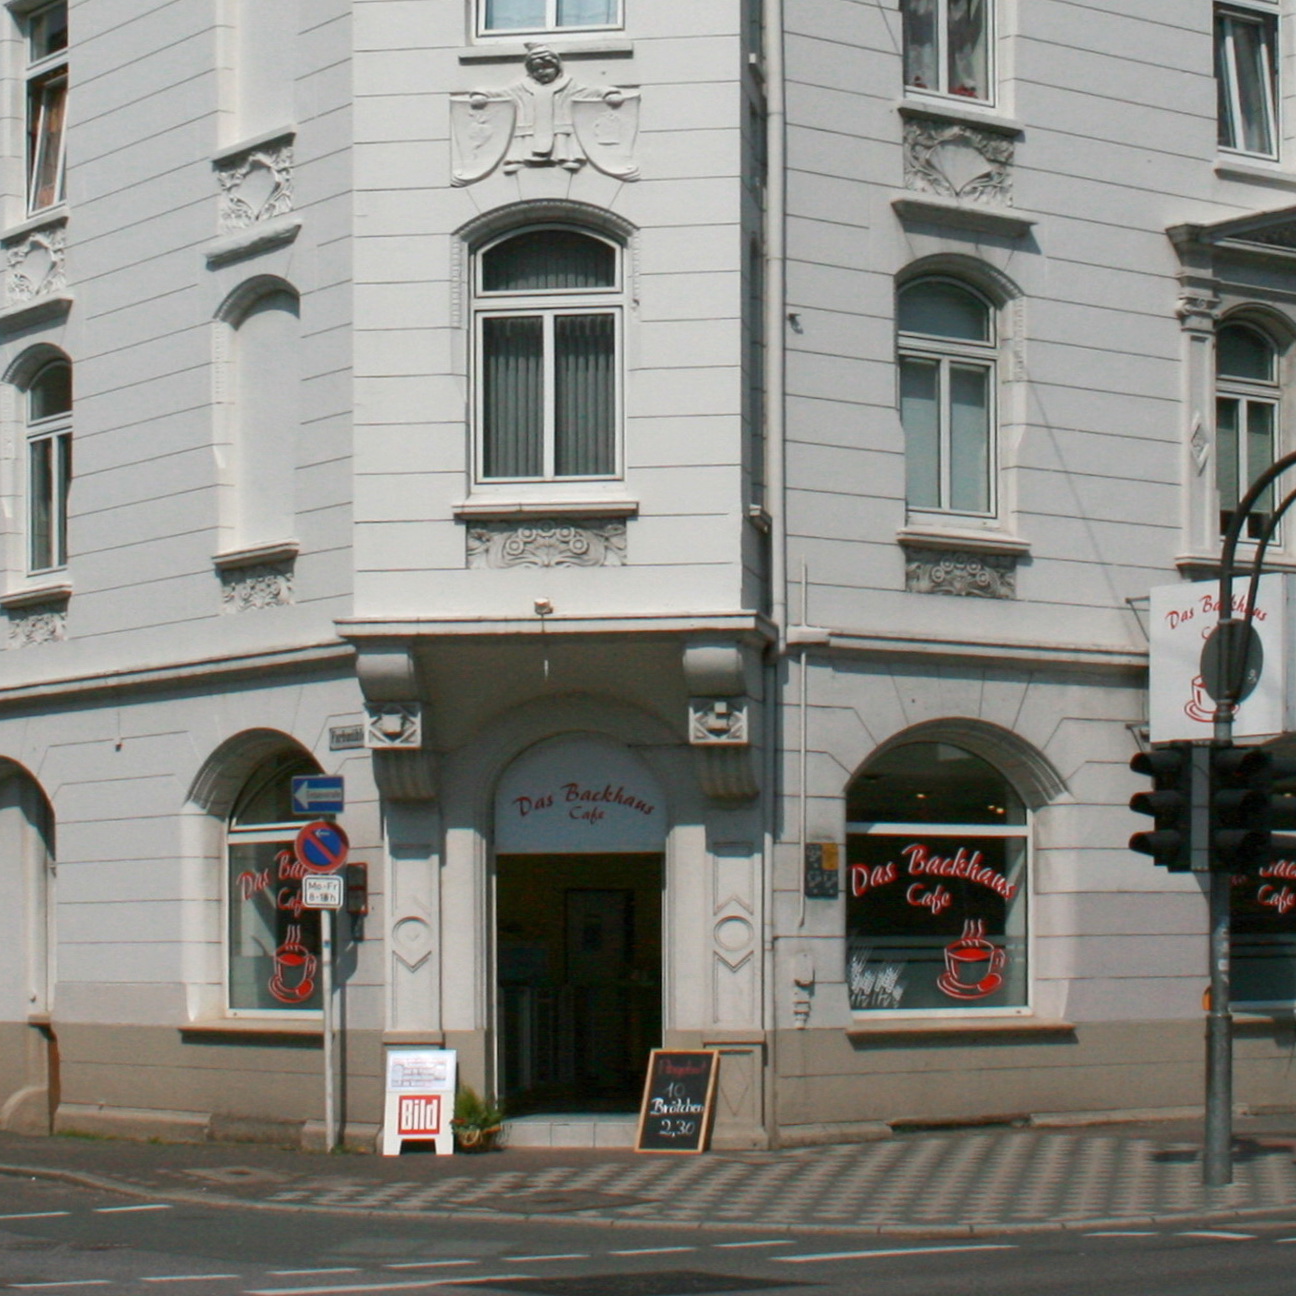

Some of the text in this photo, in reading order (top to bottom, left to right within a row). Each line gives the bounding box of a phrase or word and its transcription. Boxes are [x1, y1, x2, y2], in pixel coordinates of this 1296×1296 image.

[1165, 610, 1194, 630] Das
[513, 782, 655, 817] Das Backhaus
[568, 805, 606, 825] Cafe
[850, 861, 898, 897] Das
[902, 842, 1018, 901] Backhaus
[236, 869, 270, 902] Das
[906, 881, 953, 915] Cafe
[277, 887, 306, 919] Caf
[666, 1082, 685, 1098] 10
[650, 1097, 705, 1115] Brötchen
[659, 1118, 695, 1138] 2,30
